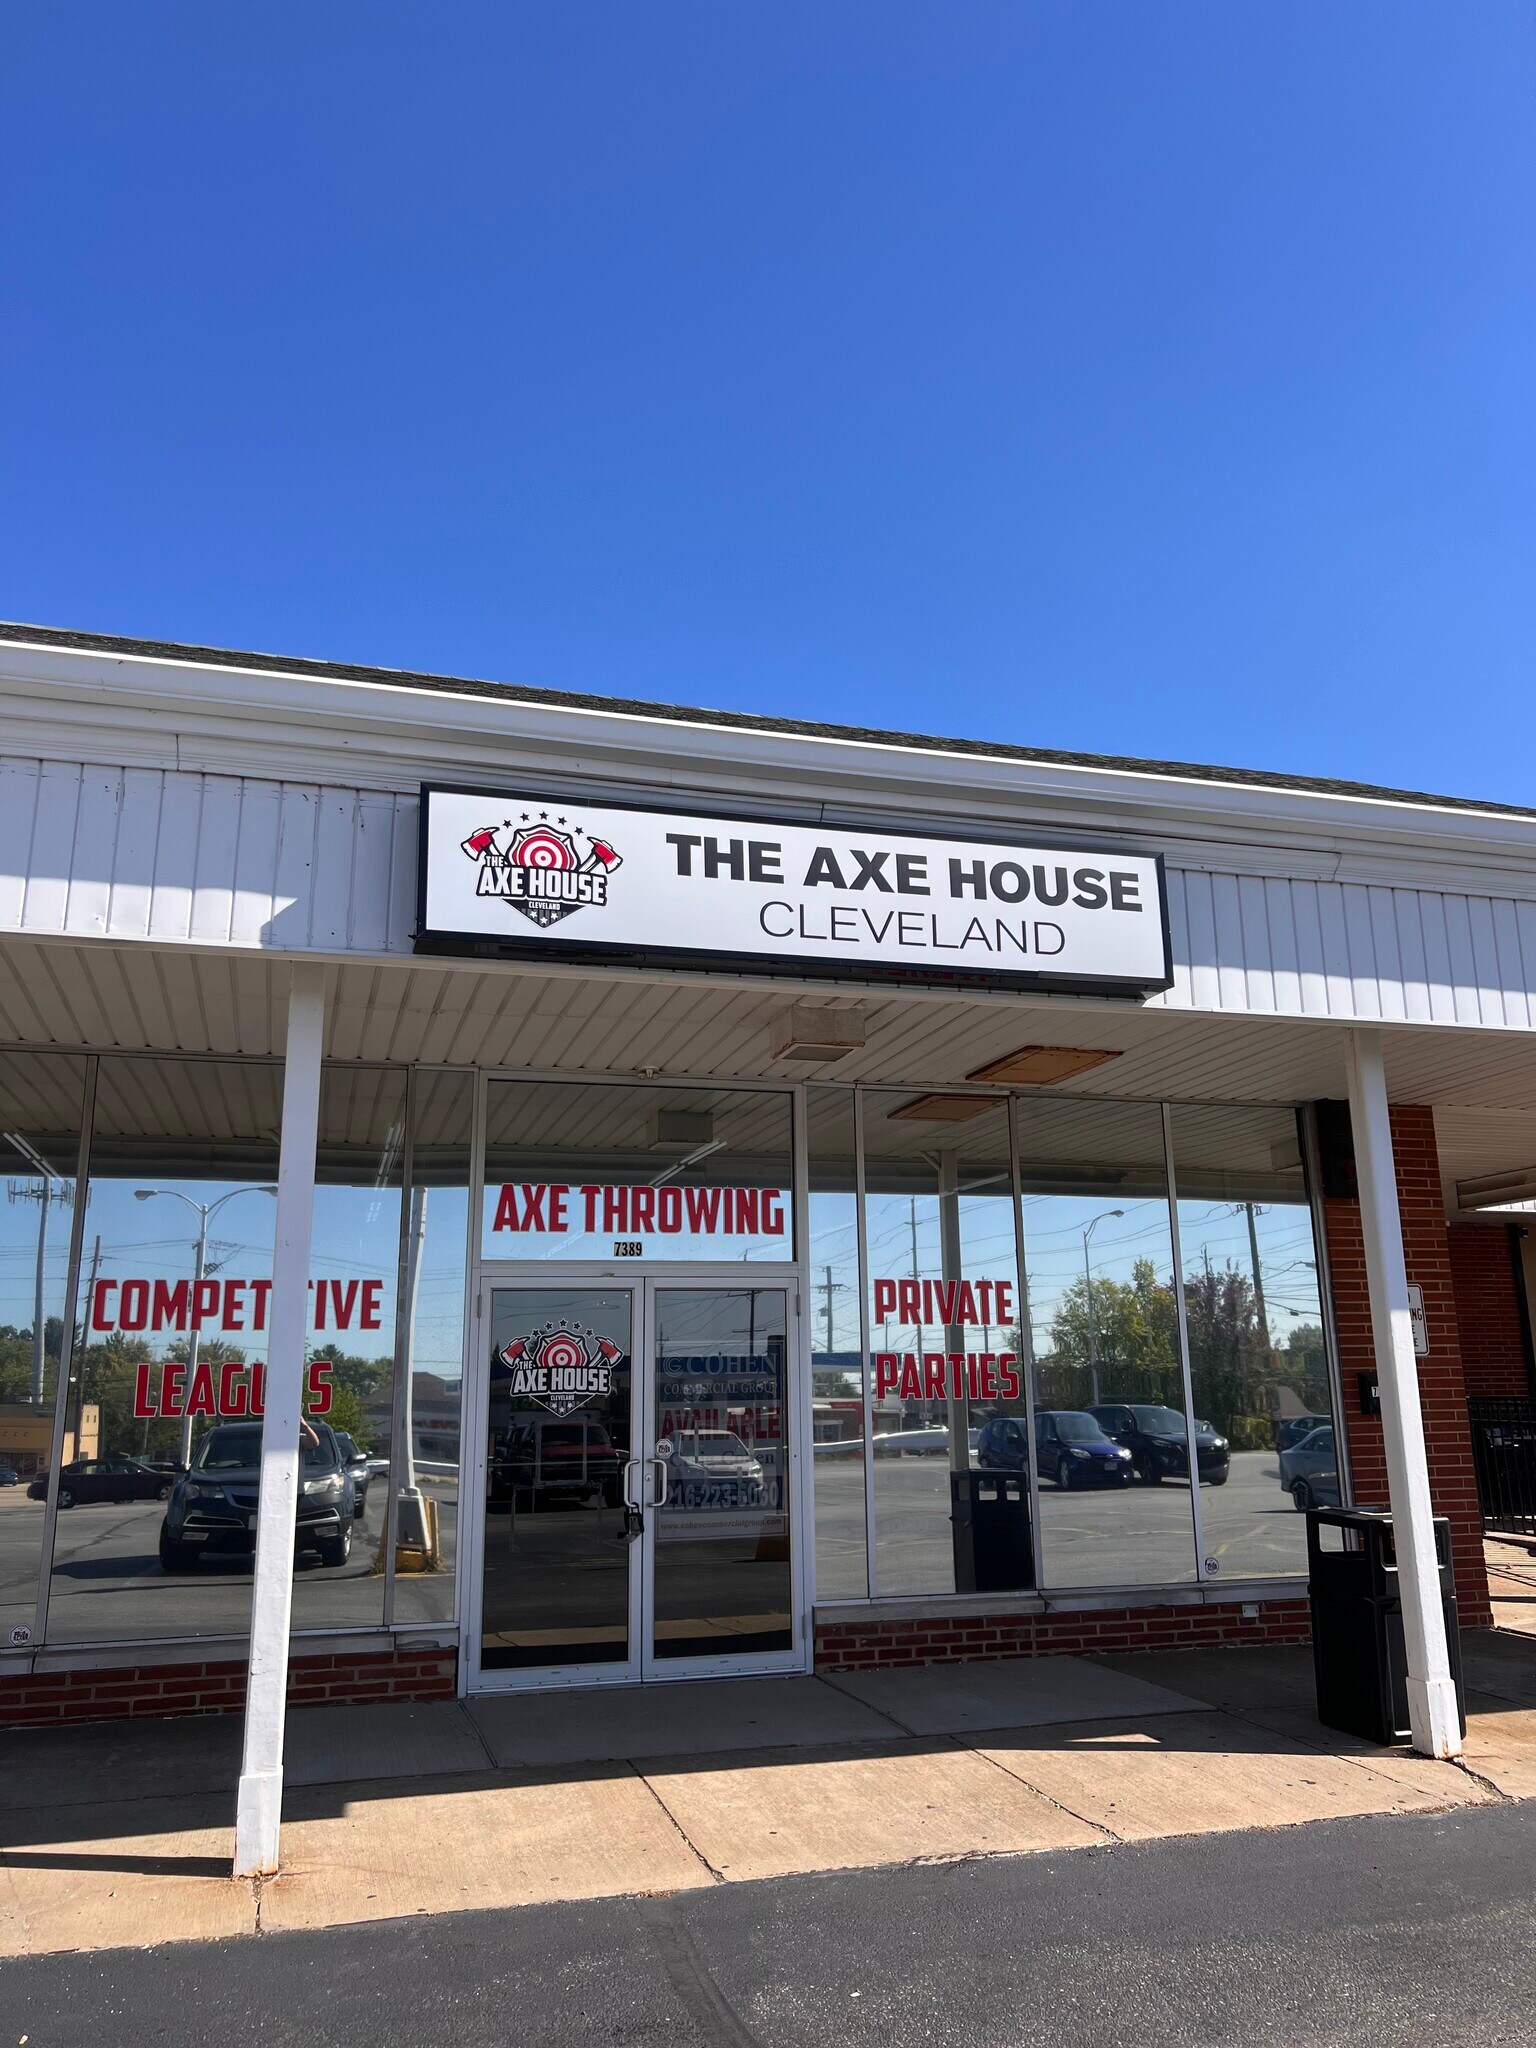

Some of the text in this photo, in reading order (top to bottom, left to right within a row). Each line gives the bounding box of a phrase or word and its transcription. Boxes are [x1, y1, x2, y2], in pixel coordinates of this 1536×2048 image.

[486, 856, 504, 867] THE
[666, 833, 1144, 912] THE AXE HOUSE
[478, 866, 606, 904] AXE HOUSE
[528, 901, 561, 911] CLEVELAND
[759, 900, 1066, 956] CLEVELAND
[492, 1182, 785, 1235] AXE THROWING
[614, 1242, 643, 1257] 7389
[92, 1279, 384, 1331] COMPETIVE
[874, 1279, 1014, 1326] PRIVATE
[513, 1367, 609, 1393] AXE HOUSE
[519, 1361, 533, 1370] THE
[686, 1353, 779, 1376] COHEN
[876, 1352, 1020, 1400] PARTIES
[661, 1407, 781, 1441] AVAILABLE
